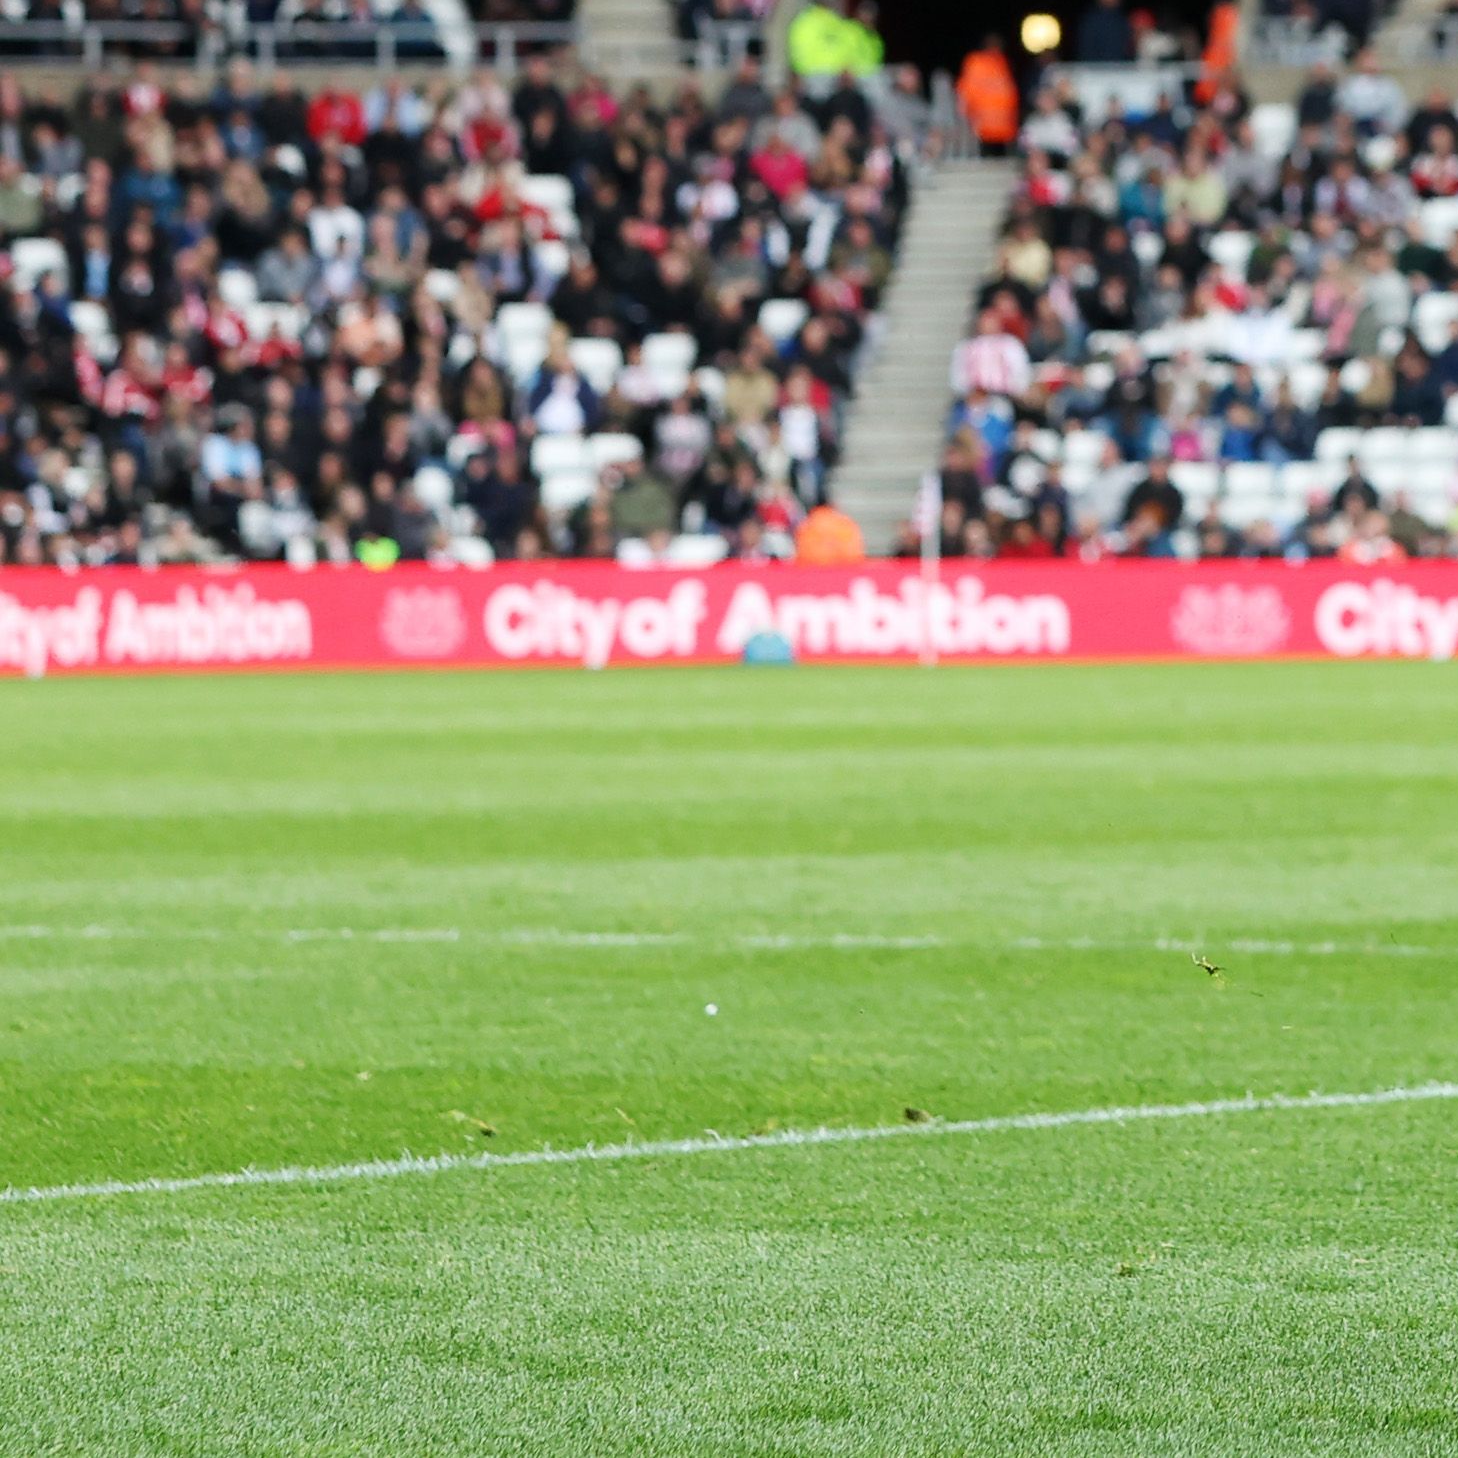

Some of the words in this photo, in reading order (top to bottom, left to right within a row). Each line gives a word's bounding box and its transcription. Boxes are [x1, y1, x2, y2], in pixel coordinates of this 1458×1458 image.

[52, 585, 101, 665] of
[104, 583, 313, 662] Ambition
[484, 579, 620, 669] City
[622, 578, 706, 658] of
[717, 575, 1071, 657] Ambition
